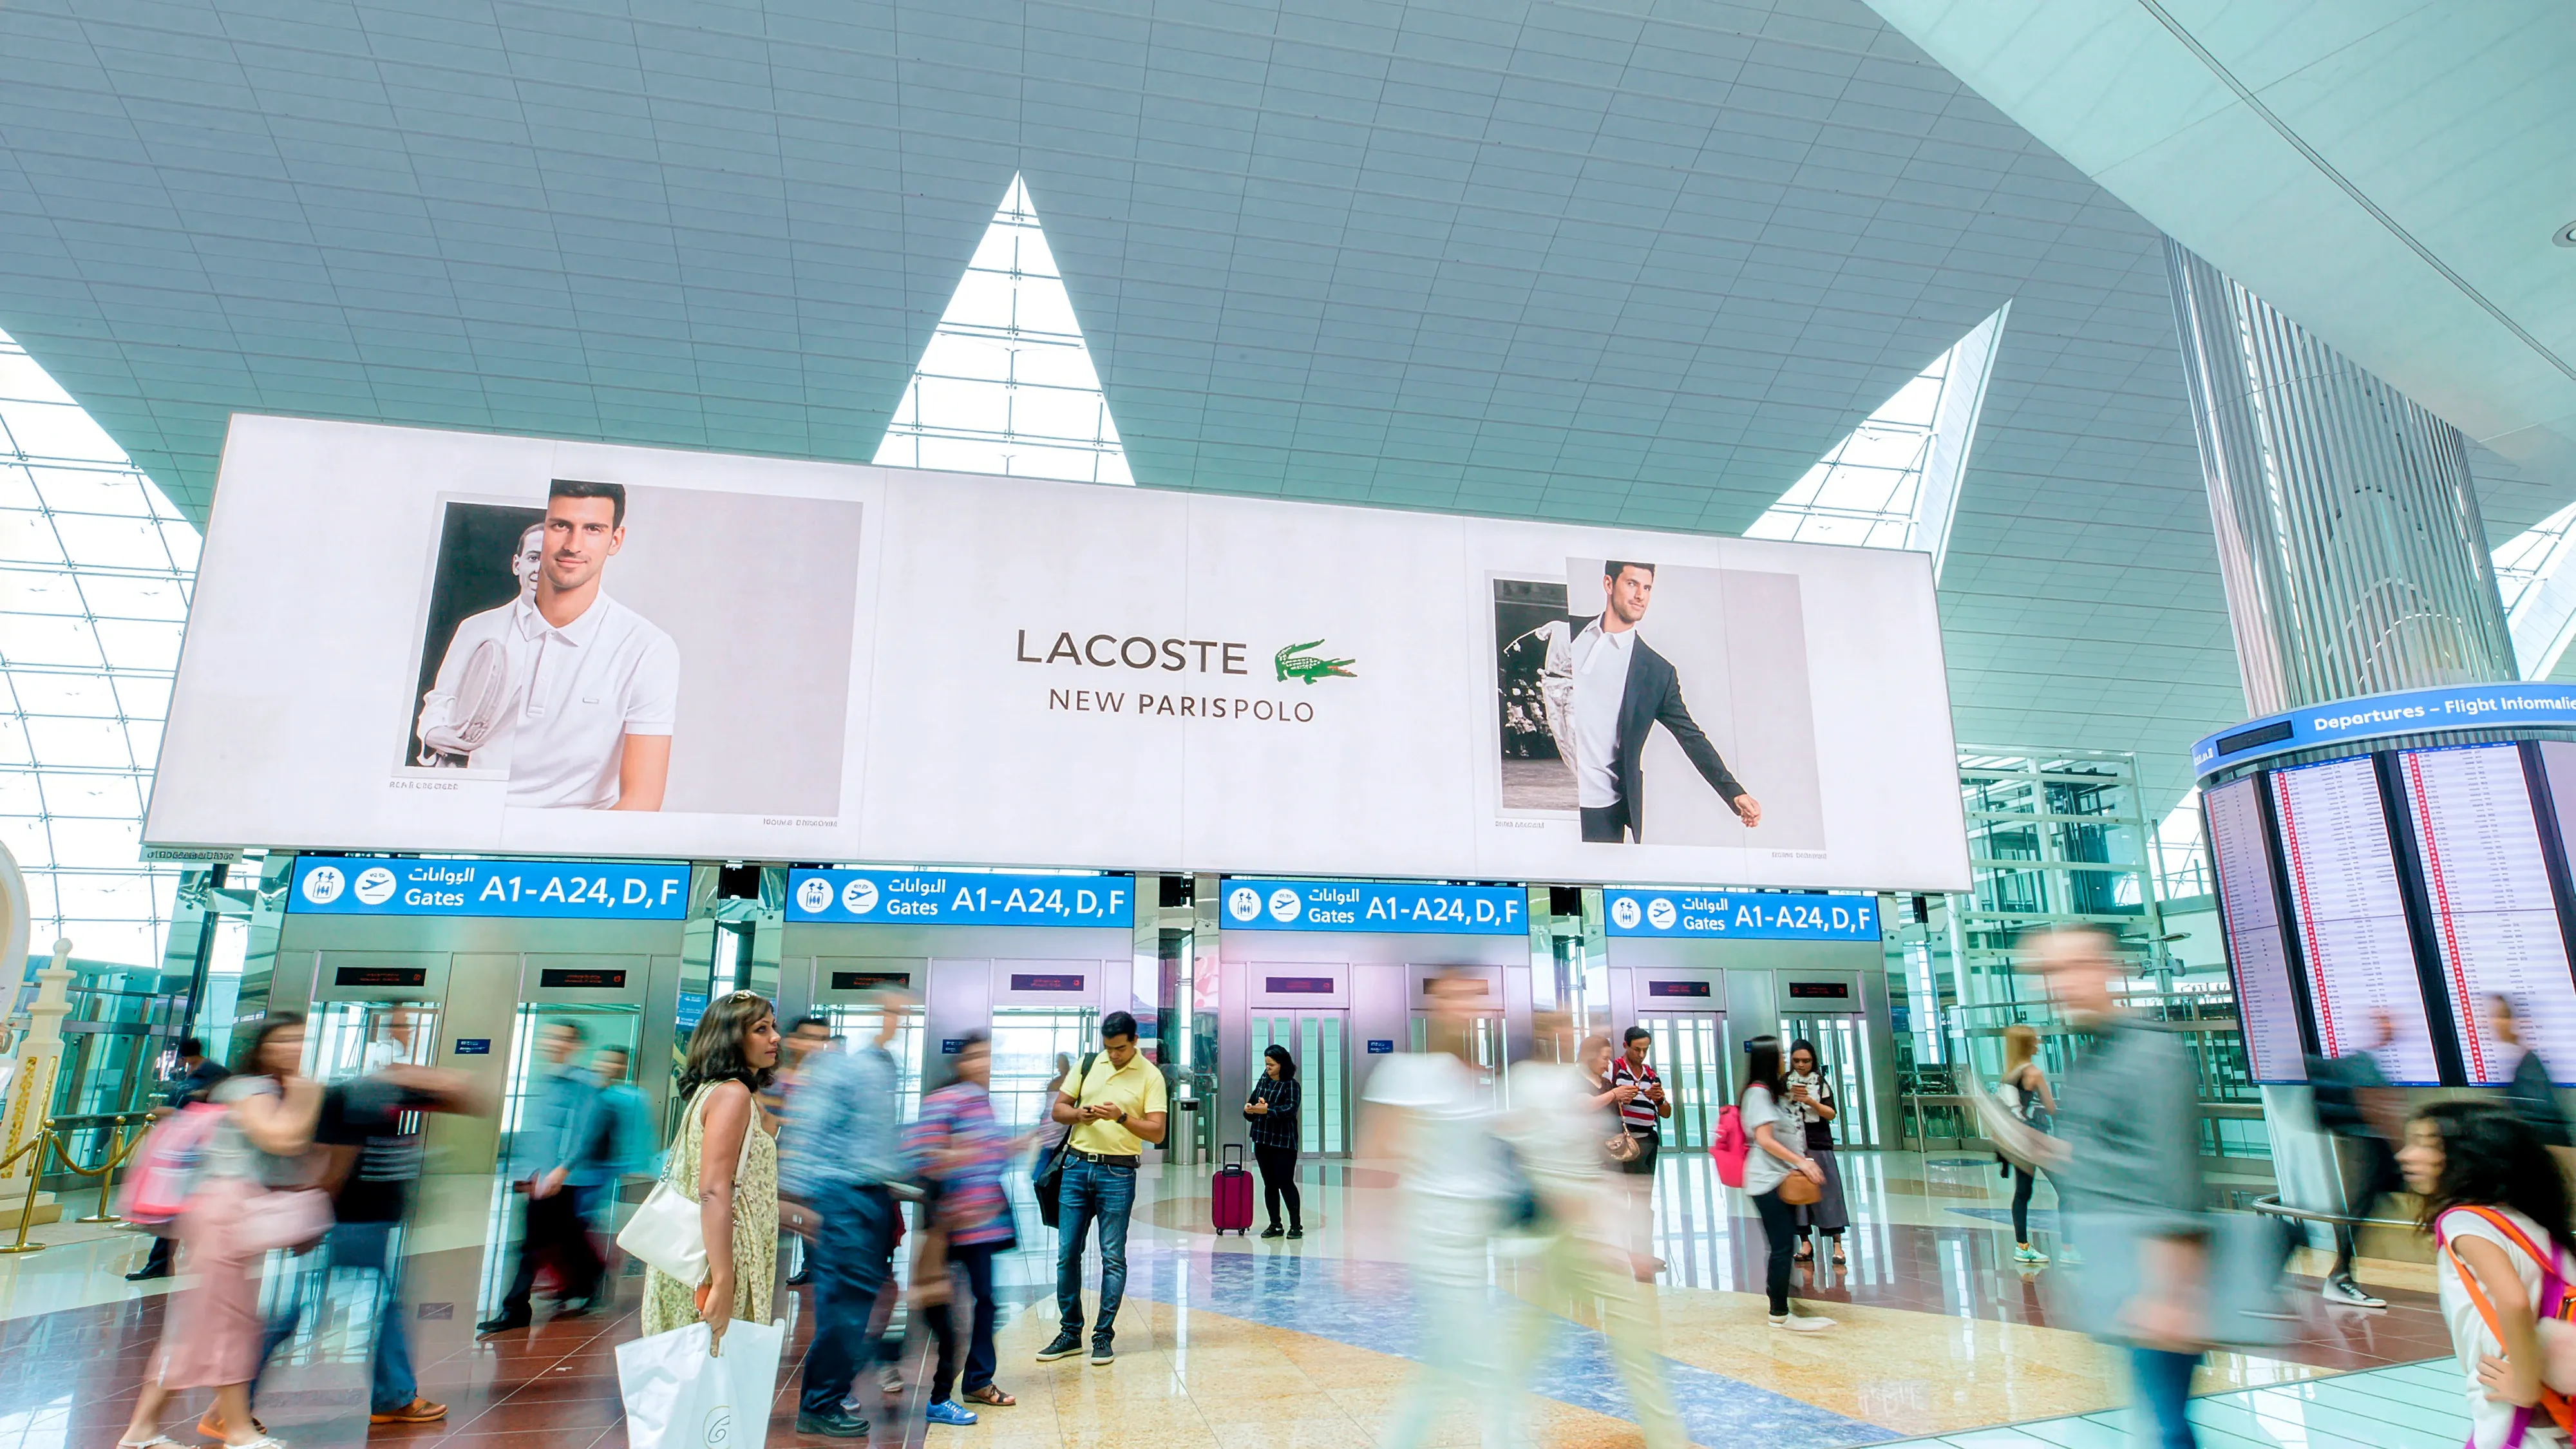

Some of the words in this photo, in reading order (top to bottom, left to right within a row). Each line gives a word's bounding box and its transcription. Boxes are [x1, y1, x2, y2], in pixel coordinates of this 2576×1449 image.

[1017, 629, 1248, 675] LACOSTE
[1050, 688, 1125, 712] NEW
[2314, 706, 2425, 731] Departures
[404, 888, 464, 906] Gates
[887, 899, 938, 915] Gates
[1308, 907, 1354, 923] Gates
[1683, 915, 1725, 931] Gates
